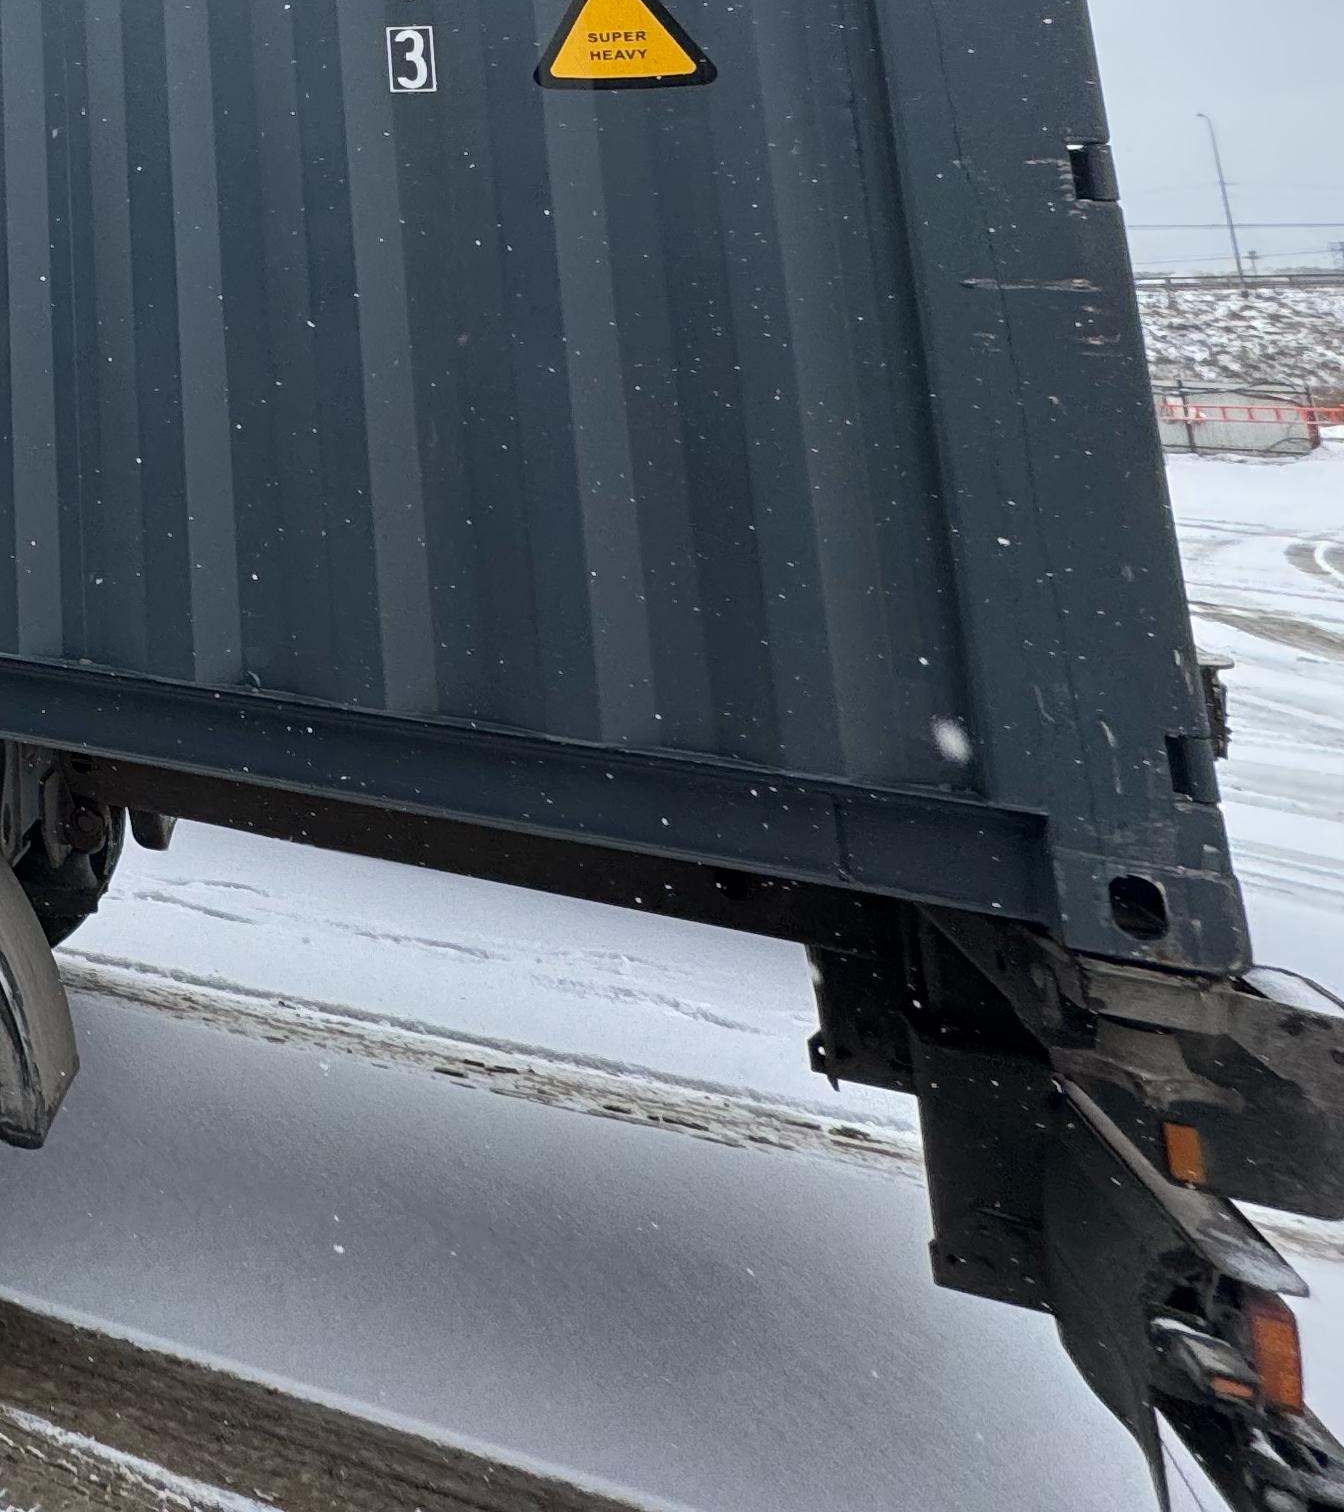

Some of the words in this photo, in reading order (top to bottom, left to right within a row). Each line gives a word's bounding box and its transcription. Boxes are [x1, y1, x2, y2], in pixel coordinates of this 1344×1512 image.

[587, 30, 647, 43] SUPER
[393, 29, 429, 89] 3
[589, 48, 648, 61] HEAVY
